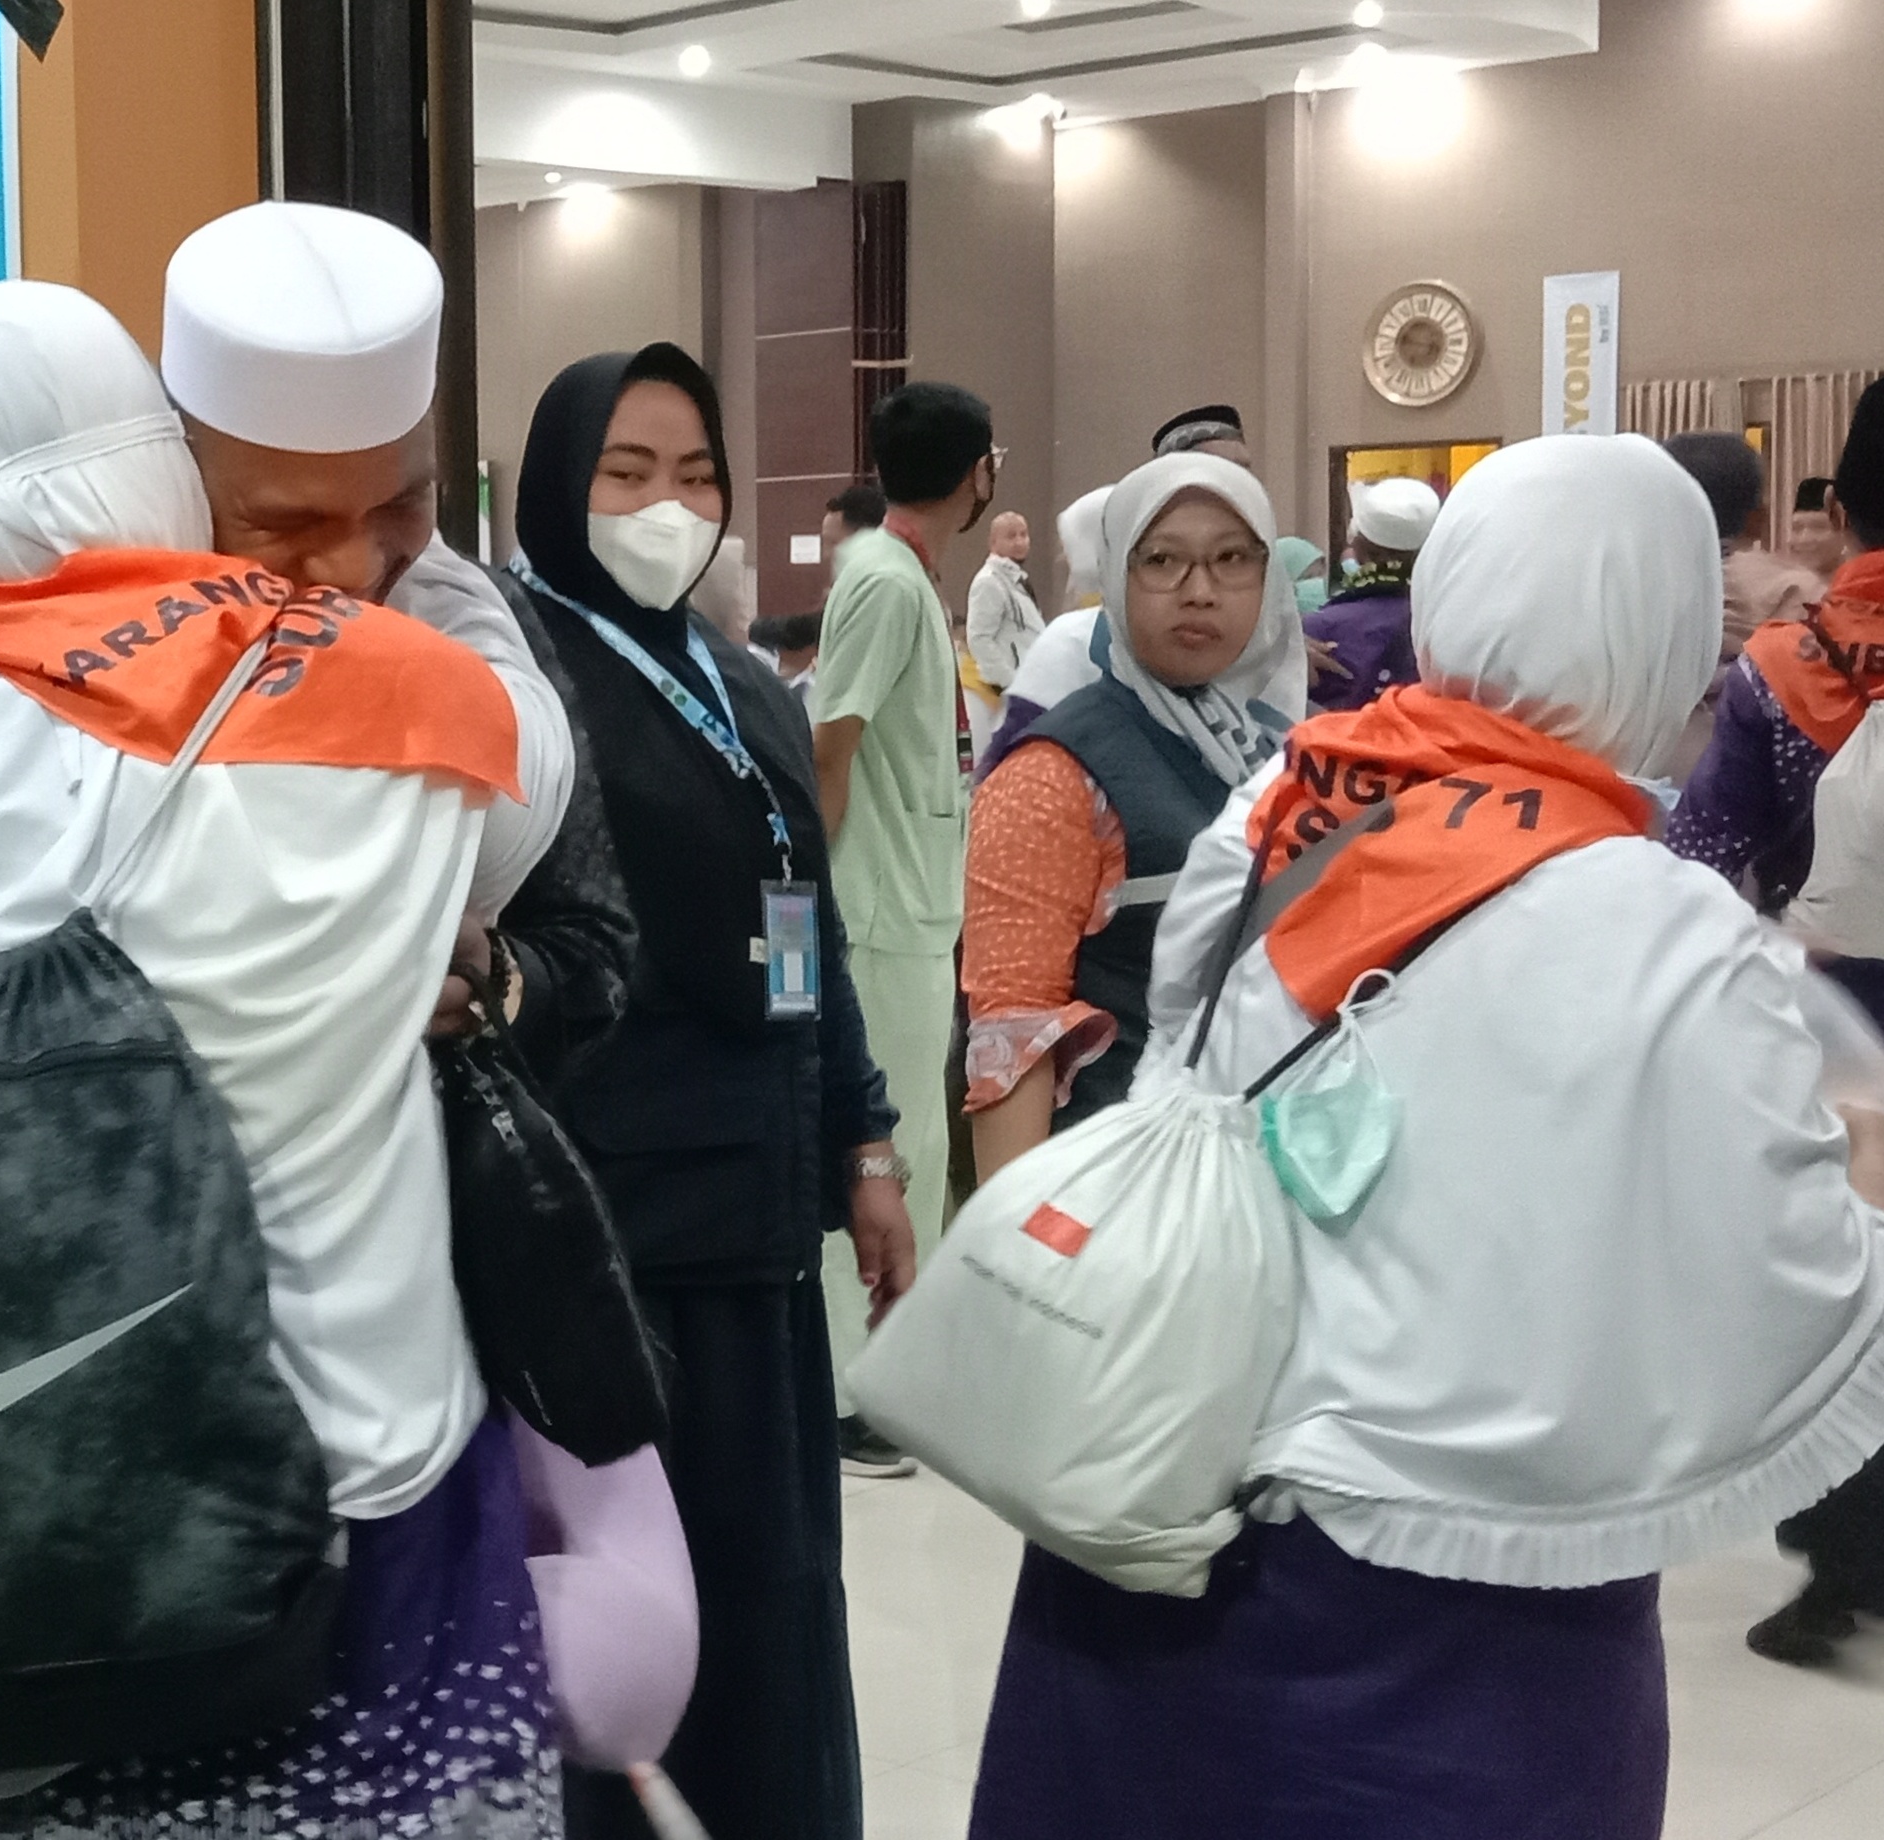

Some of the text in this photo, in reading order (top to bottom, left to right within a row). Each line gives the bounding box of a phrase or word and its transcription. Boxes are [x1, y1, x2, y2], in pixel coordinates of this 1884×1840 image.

[1563, 303, 1591, 434] YOND
[61, 570, 293, 690] ARANG
[1439, 777, 1543, 830] 71
